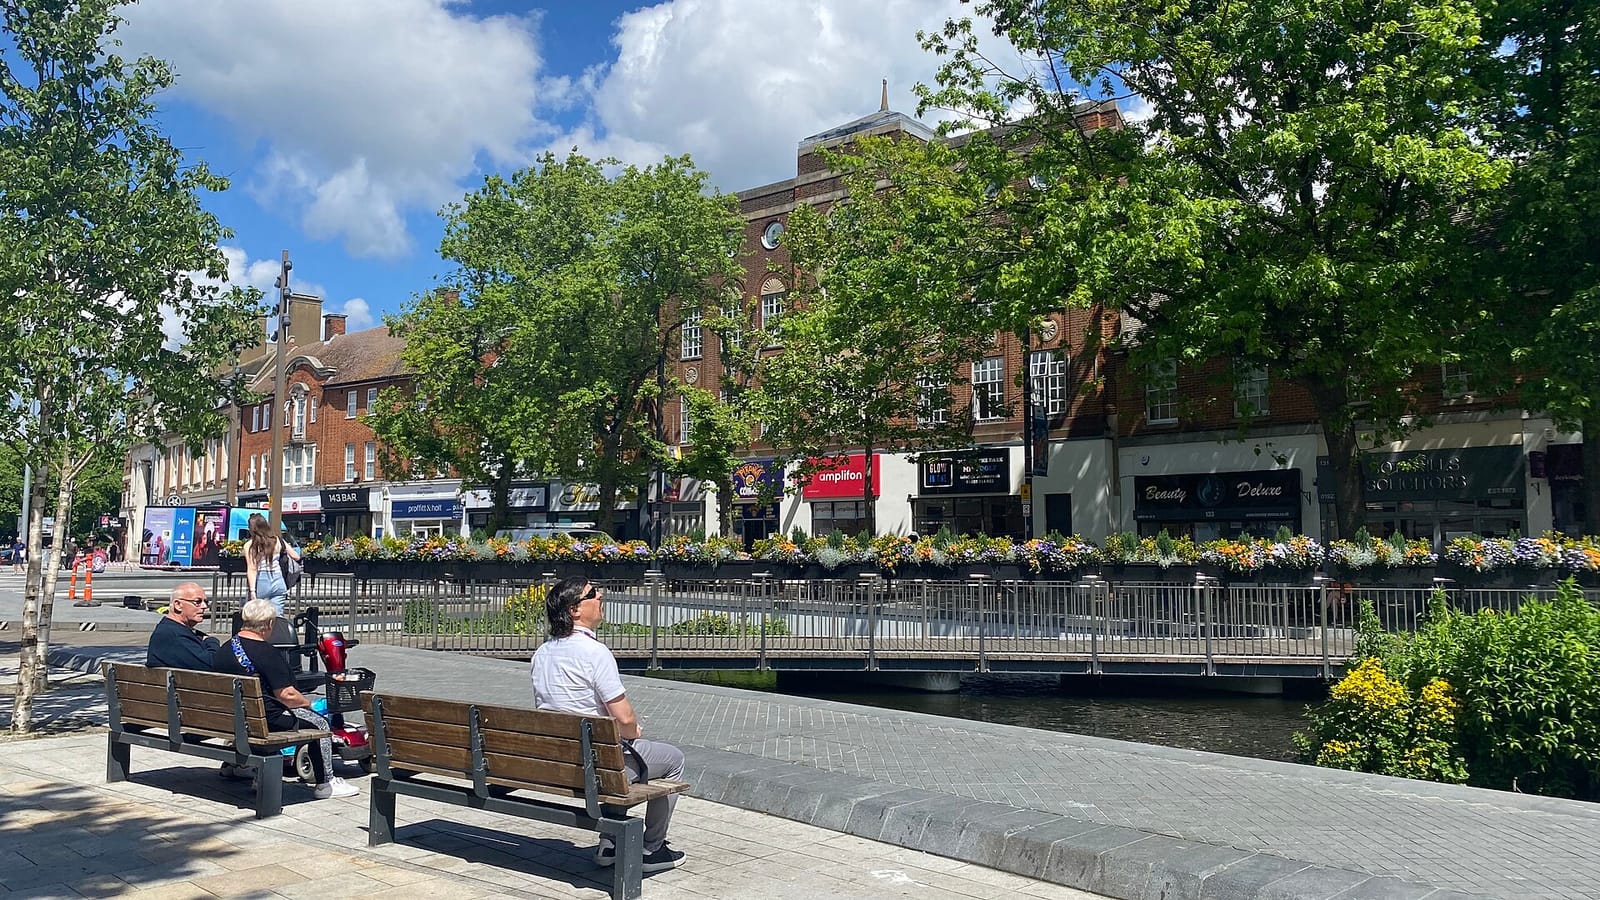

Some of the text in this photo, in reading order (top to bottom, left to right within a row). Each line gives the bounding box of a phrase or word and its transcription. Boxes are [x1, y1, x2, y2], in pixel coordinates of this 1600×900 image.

[929, 462, 947, 474] GLOW
[819, 469, 862, 484] amplifon
[1366, 475, 1468, 492] SOLICITORS
[1145, 485, 1188, 503] Beauty
[1236, 482, 1282, 497] Deluxe
[328, 493, 358, 503] 143 BAR
